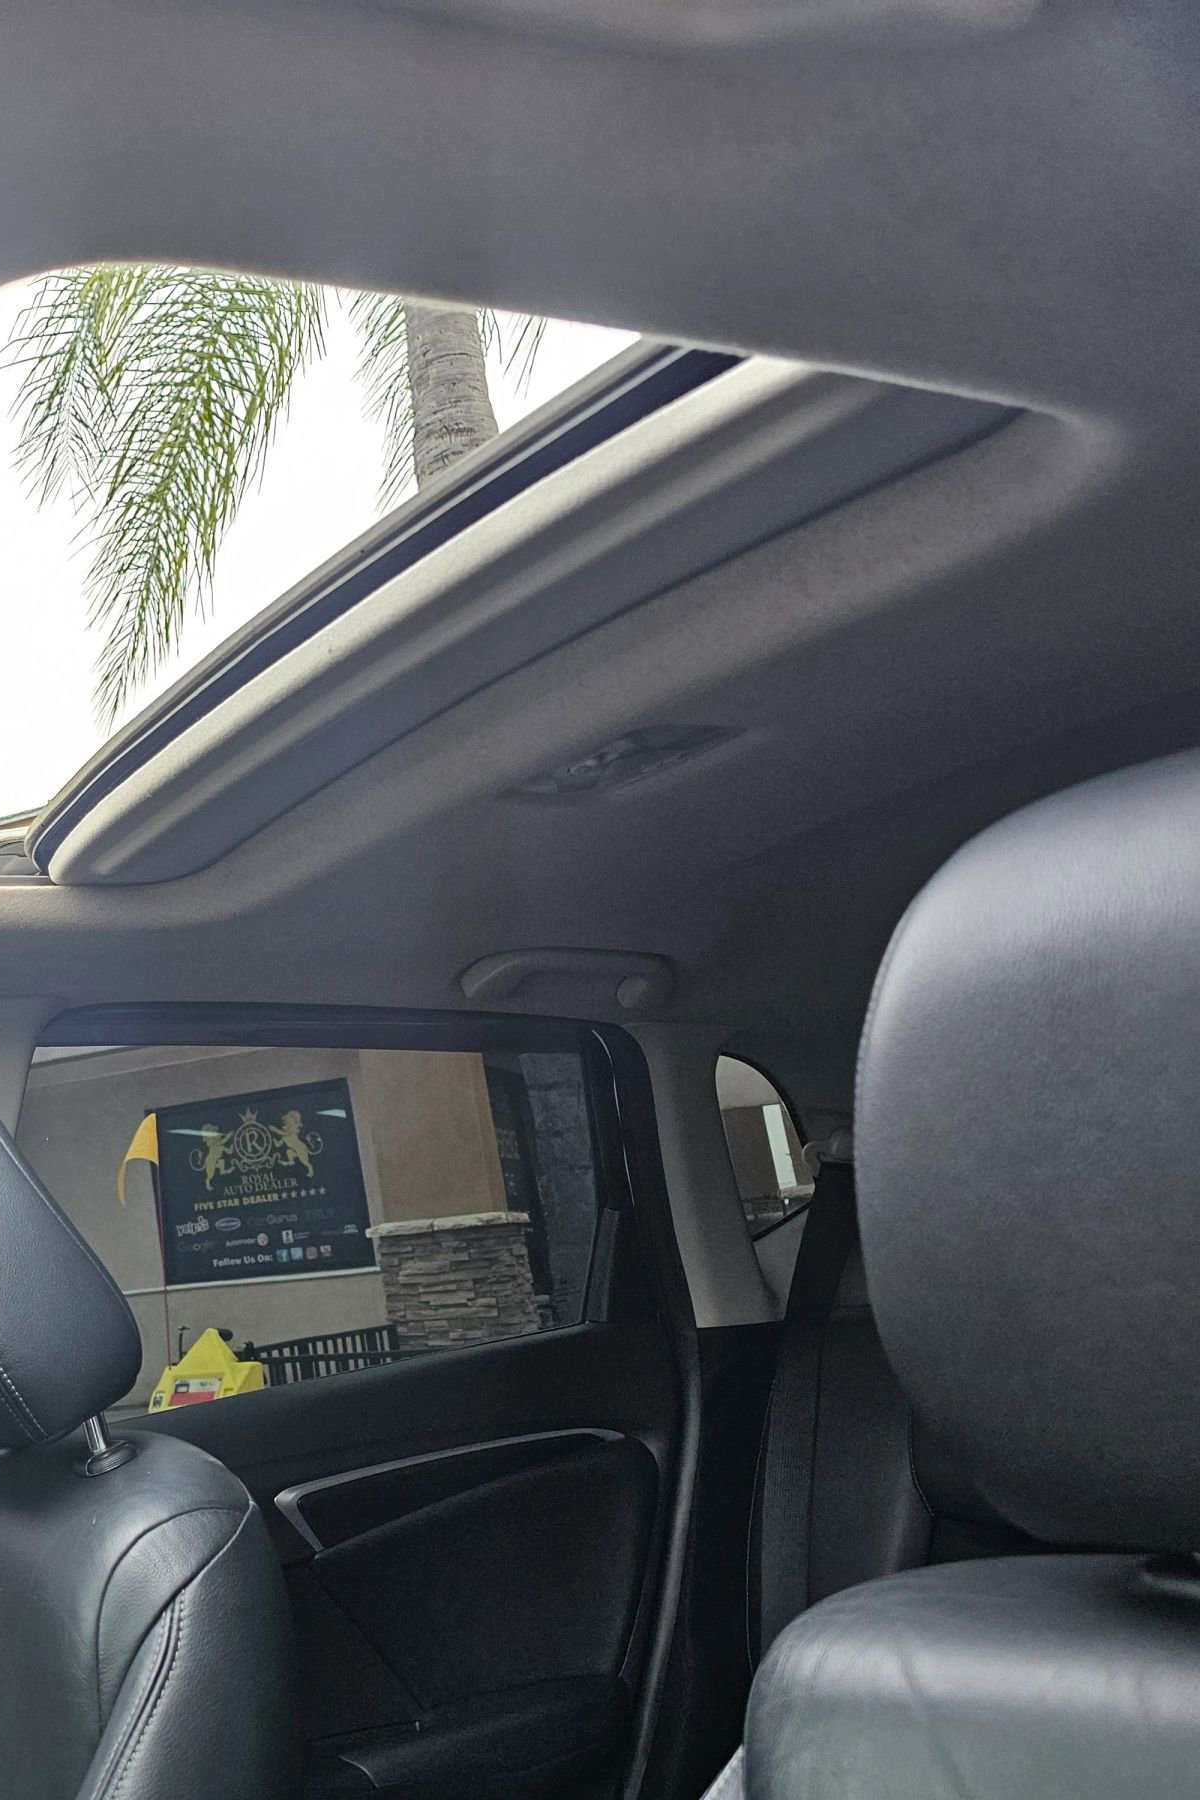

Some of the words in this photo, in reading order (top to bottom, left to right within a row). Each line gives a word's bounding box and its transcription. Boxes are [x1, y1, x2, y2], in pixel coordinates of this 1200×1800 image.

[224, 1182, 253, 1196] AUTO
[255, 1177, 299, 1192] DEALER
[241, 1172, 278, 1185] ROYAL
[194, 1201, 215, 1212] FIVE
[216, 1197, 240, 1209] STAR
[242, 1192, 280, 1205] DEALER
[213, 1256, 242, 1268] Follow
[243, 1254, 256, 1264] Us
[257, 1253, 273, 1263] On:
